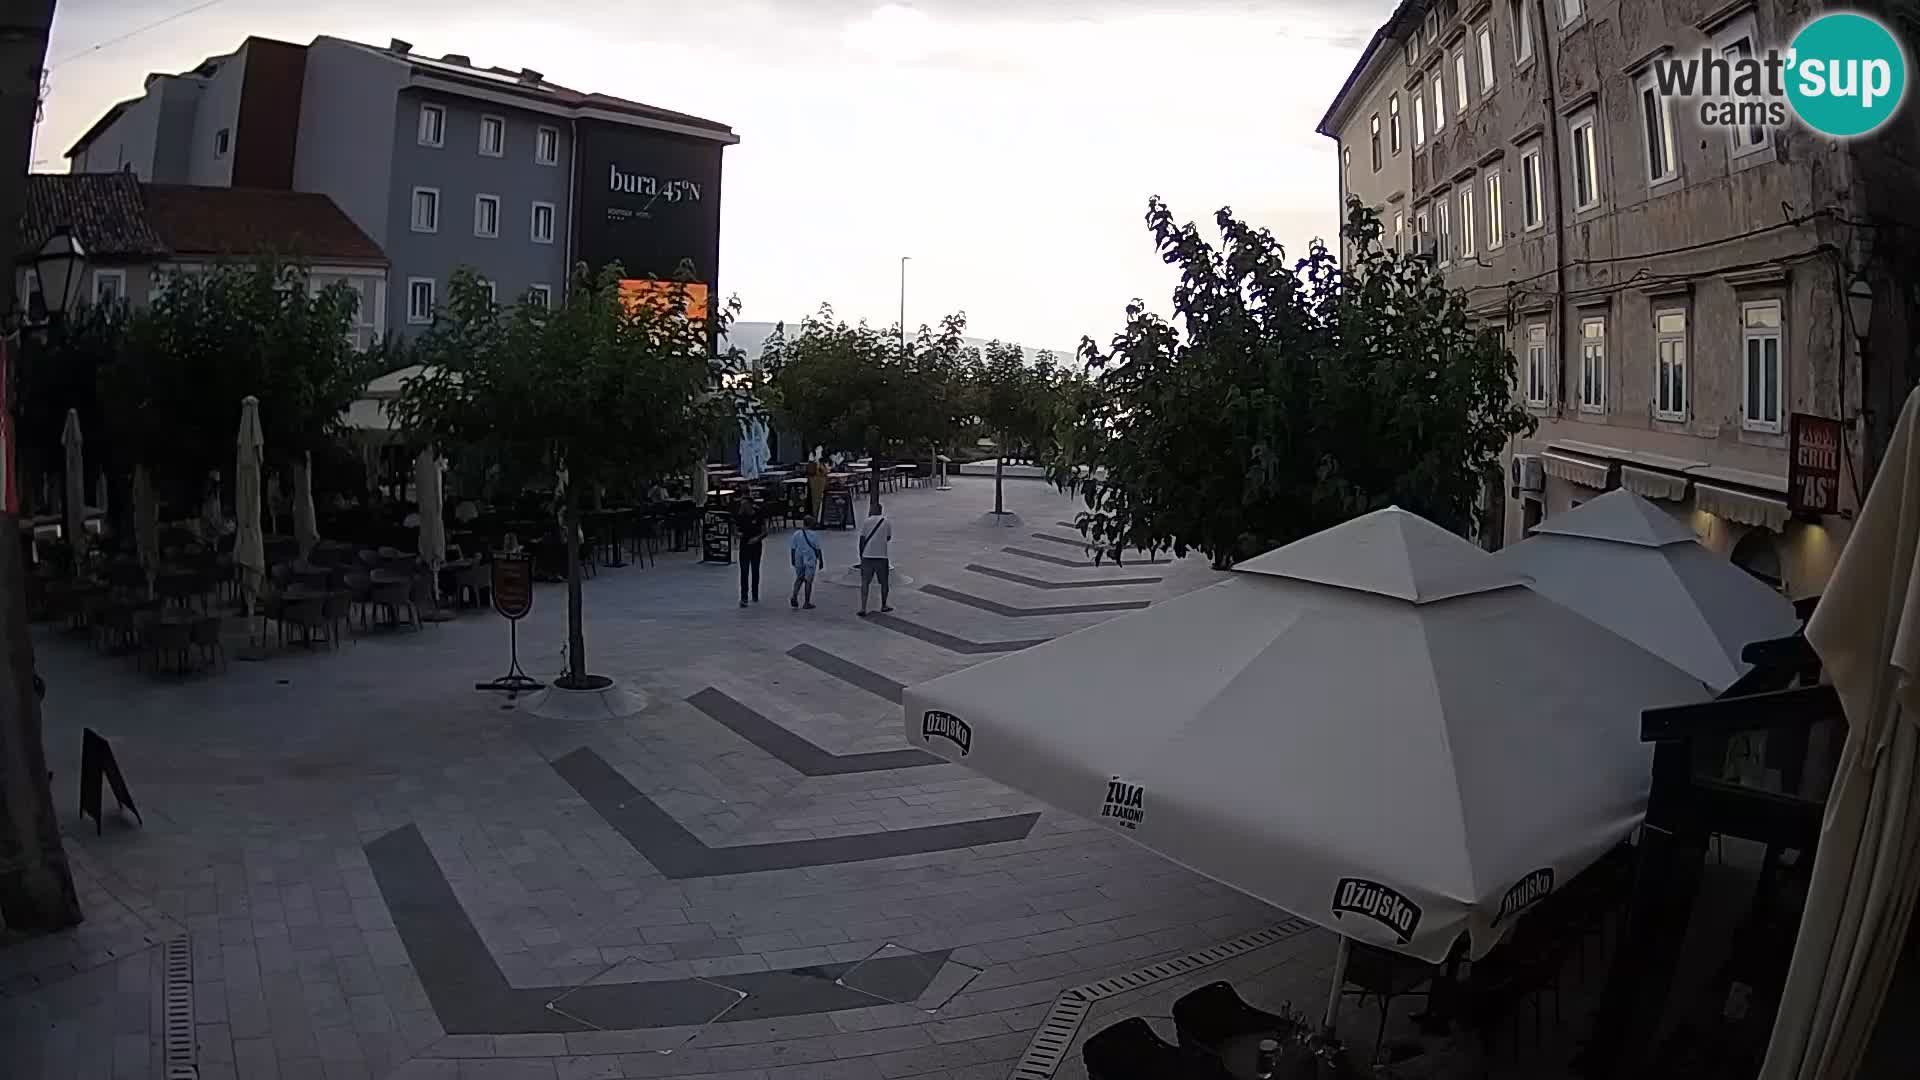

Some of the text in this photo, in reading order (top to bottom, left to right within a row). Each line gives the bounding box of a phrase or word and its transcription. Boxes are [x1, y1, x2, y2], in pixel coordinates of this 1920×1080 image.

[610, 164, 657, 196] bura
[1798, 447, 1837, 471] GRILL
[926, 712, 968, 746] Ožujsko
[1106, 775, 1144, 809] ŽUJA
[1102, 804, 1112, 817] JE
[1340, 881, 1413, 932] Ožujsko
